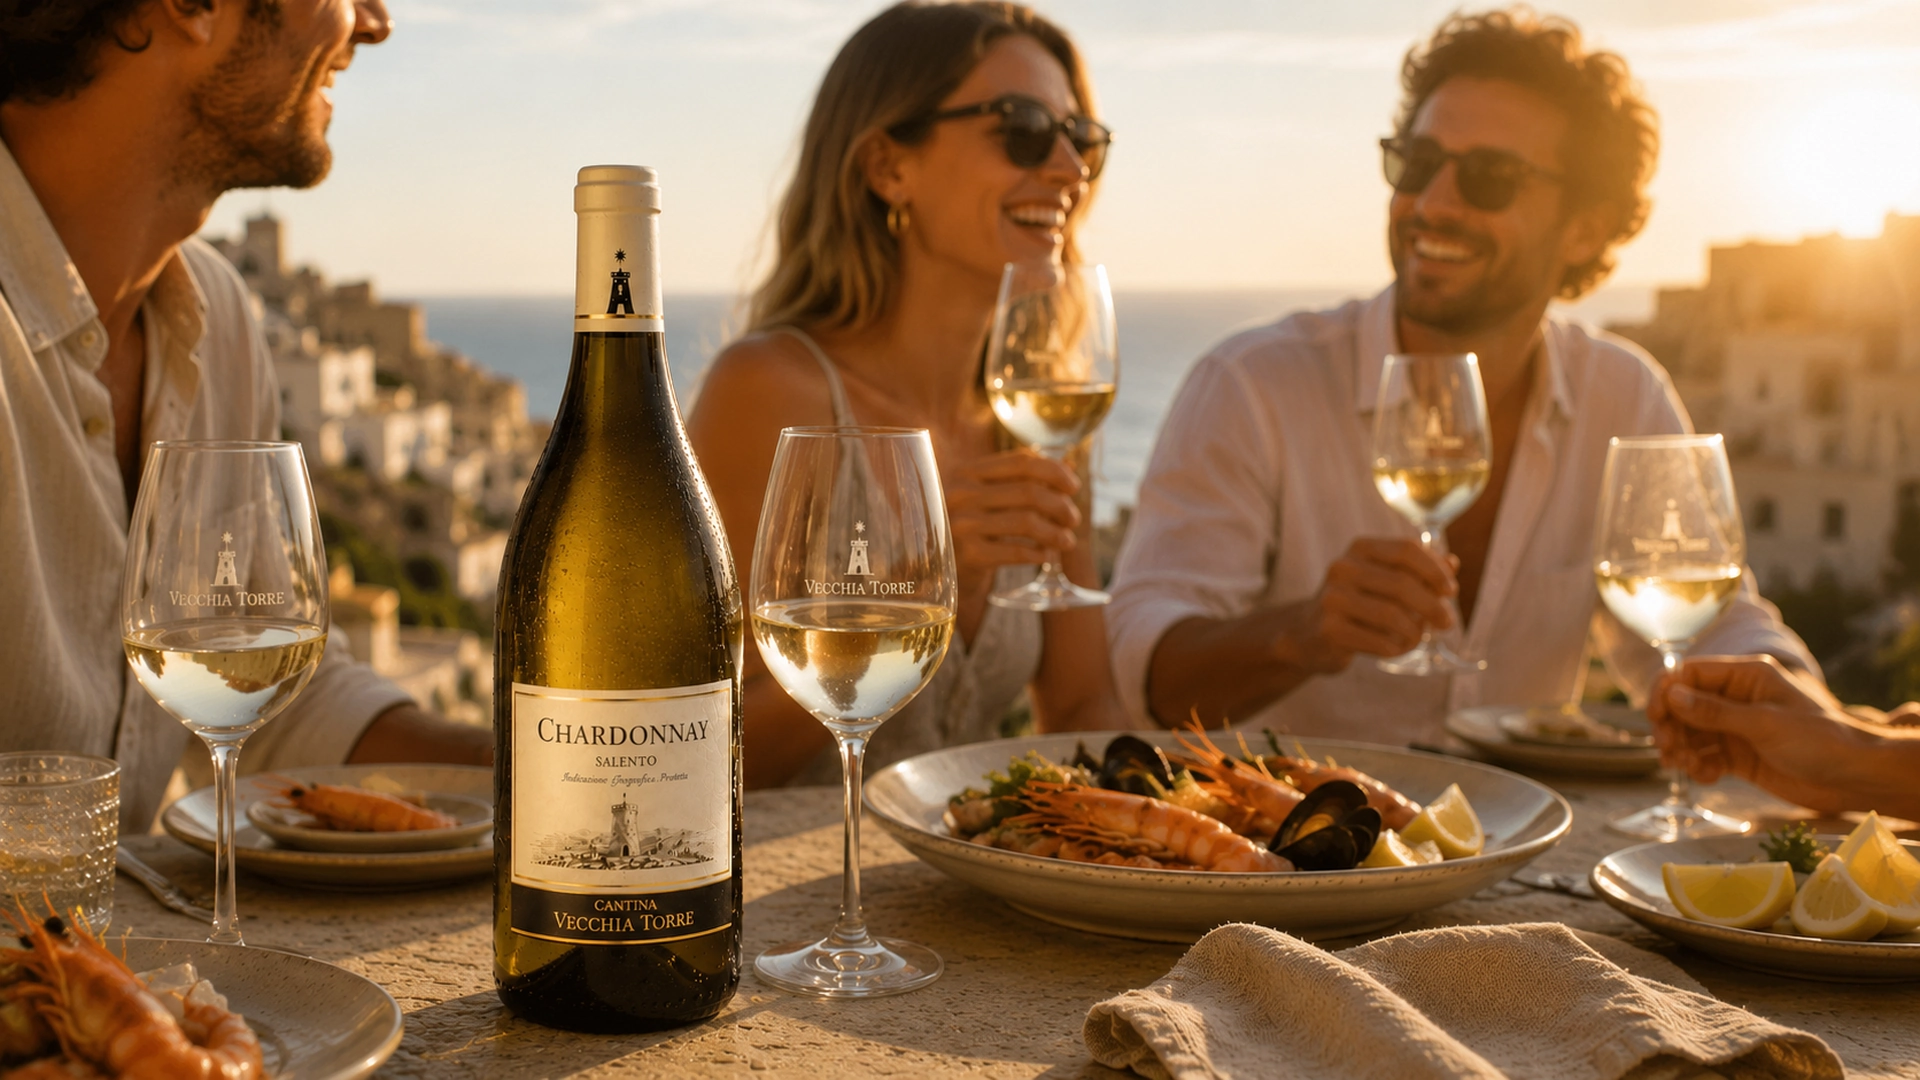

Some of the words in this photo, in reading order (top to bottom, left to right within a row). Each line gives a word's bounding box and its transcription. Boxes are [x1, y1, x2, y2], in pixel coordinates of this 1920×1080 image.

[804, 579, 866, 595] VECCHIA
[869, 580, 915, 595] TORRE
[169, 590, 232, 606] VECCHIA
[236, 591, 285, 606] TORRE
[537, 717, 709, 746] CHARDONNAY
[595, 755, 658, 767] SALENTO
[594, 899, 658, 911] CANTINA
[553, 911, 635, 932] VECCHIA
[640, 910, 695, 931] TORRE
